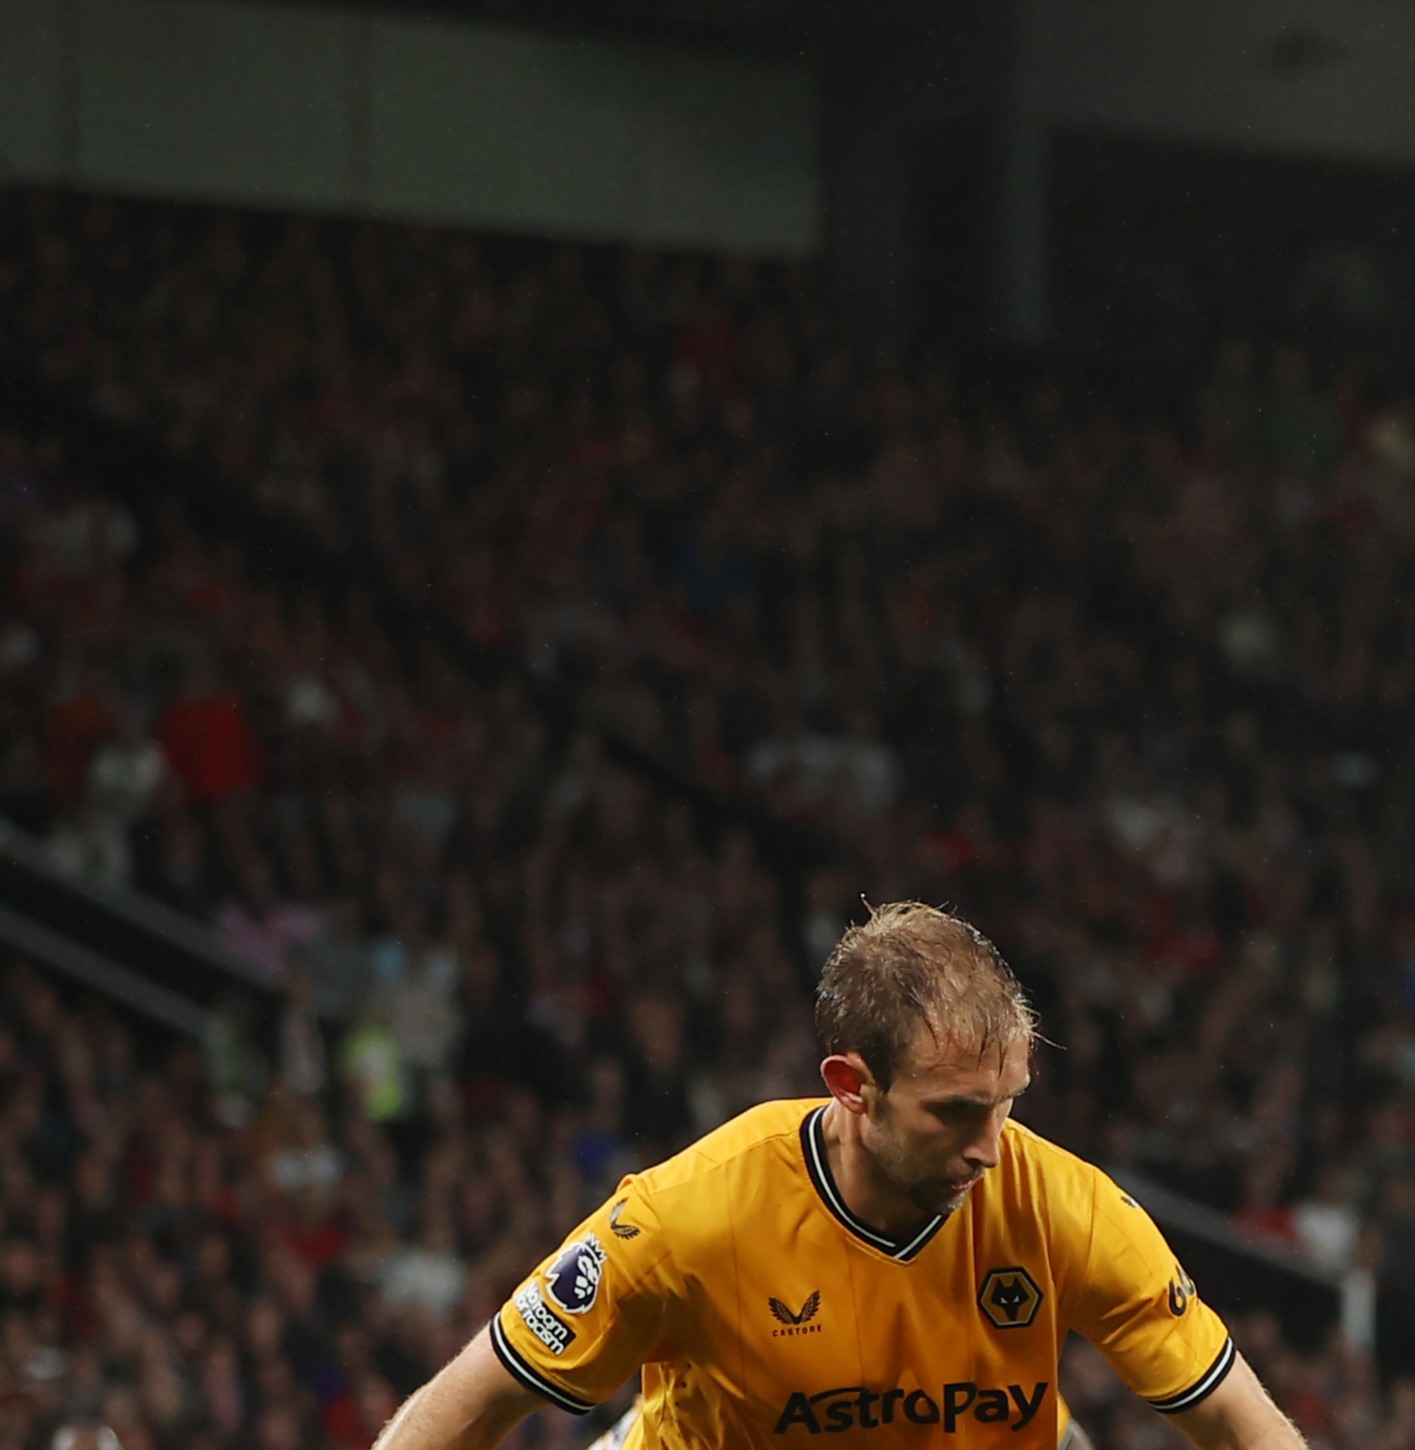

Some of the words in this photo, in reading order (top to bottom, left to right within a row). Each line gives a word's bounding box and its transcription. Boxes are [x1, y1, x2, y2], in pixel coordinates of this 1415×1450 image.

[522, 1309, 565, 1355] racism
[532, 1301, 568, 1340] room
[771, 1324, 823, 1337] CASTORE
[773, 1382, 1048, 1434] AstroPay
